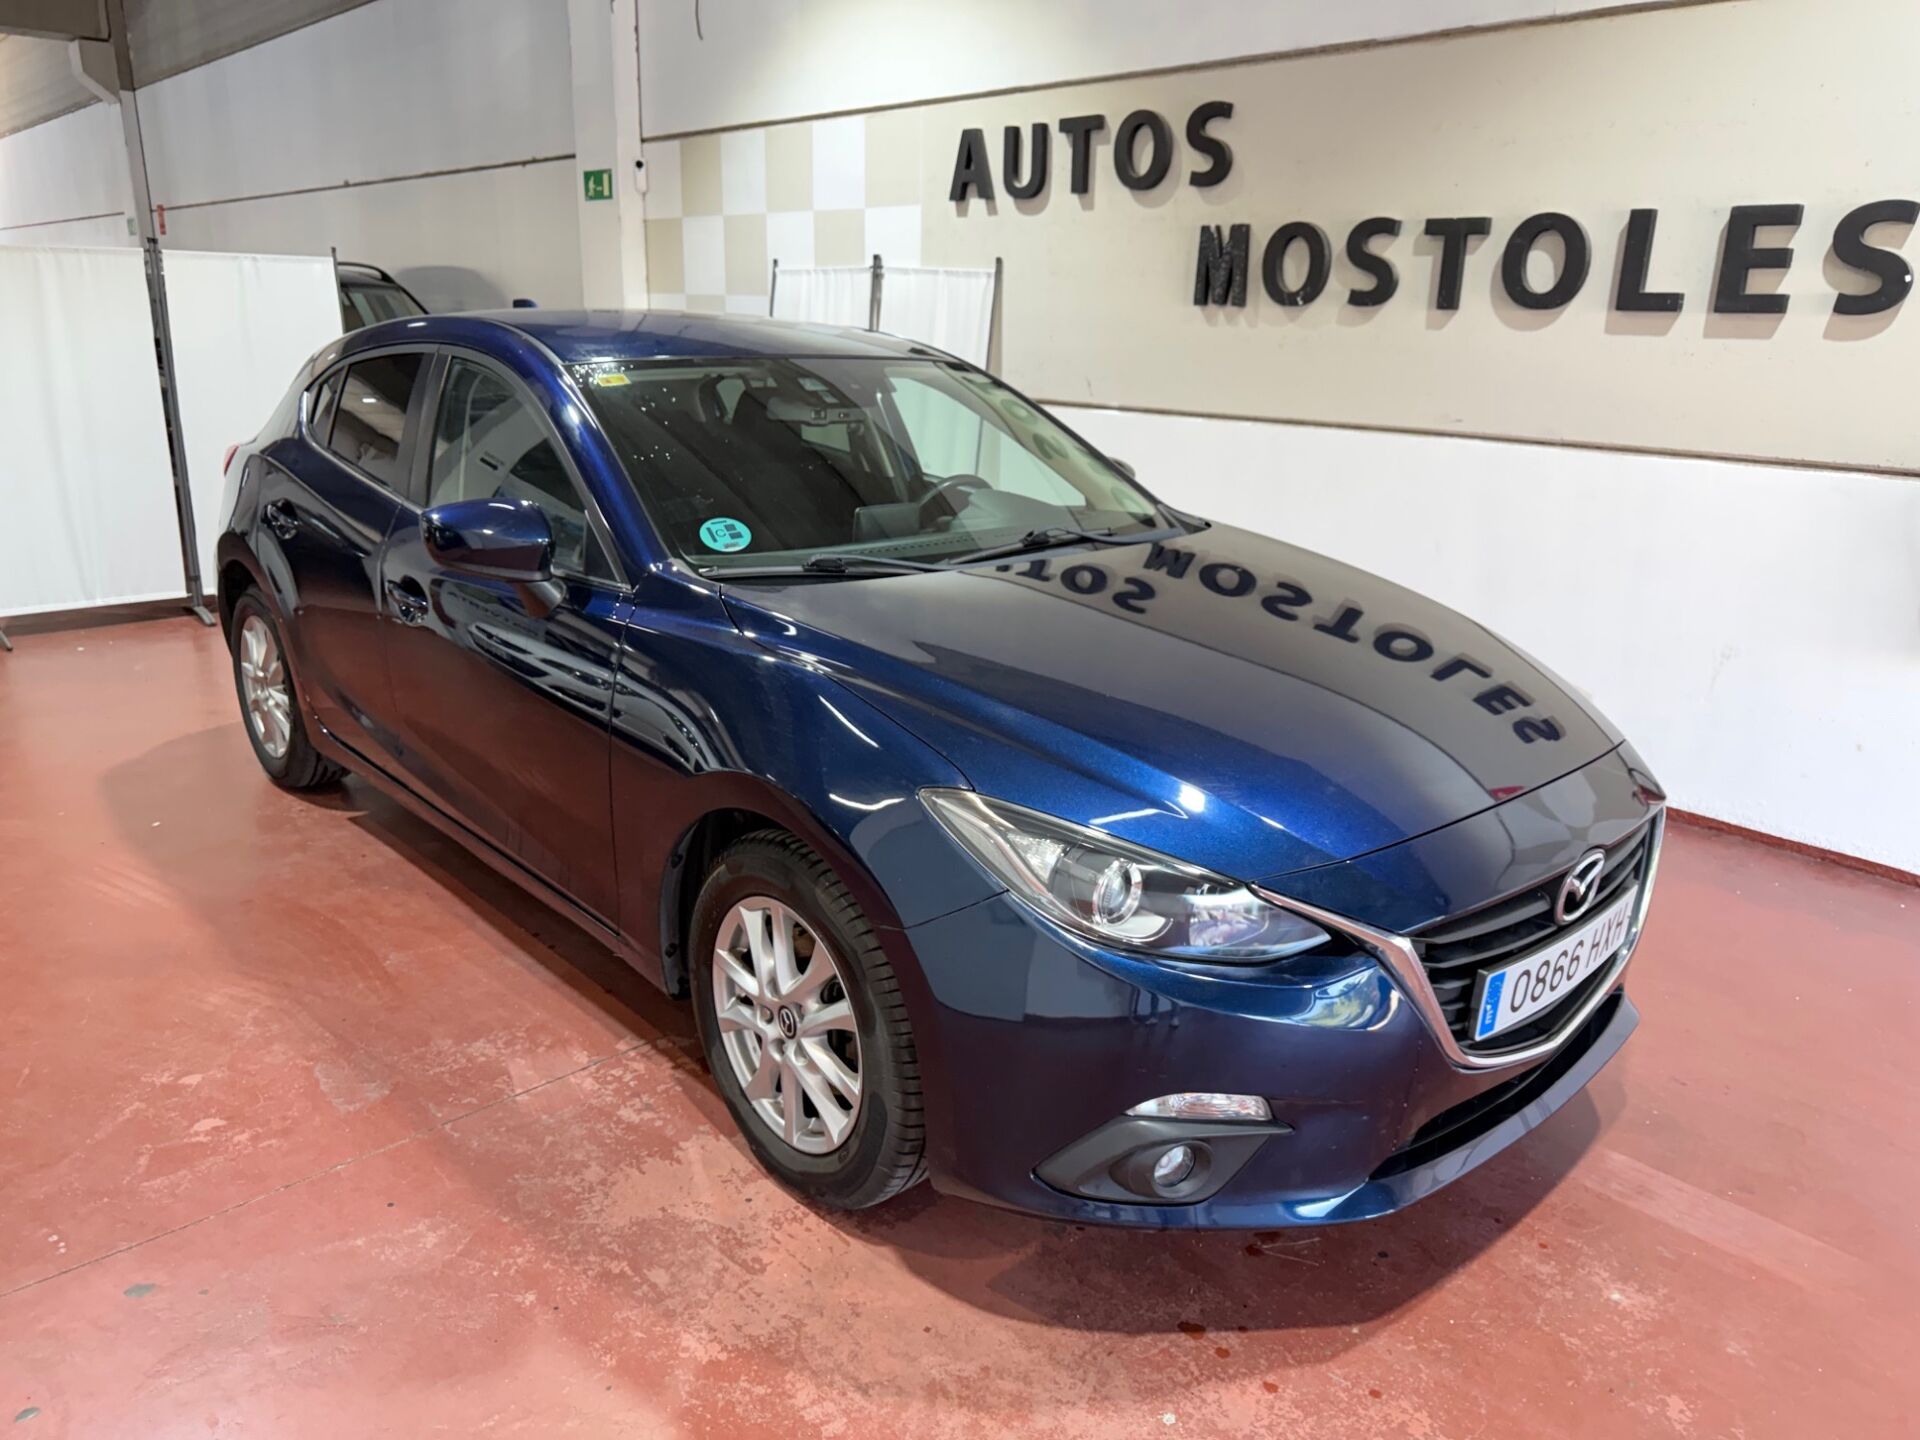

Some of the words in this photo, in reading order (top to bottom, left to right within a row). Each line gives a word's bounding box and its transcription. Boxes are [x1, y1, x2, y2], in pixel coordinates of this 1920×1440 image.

[950, 100, 1233, 200] AUTOS
[1194, 199, 1920, 315] MOSTOLES
[1510, 939, 1584, 1013] 0866
[1585, 901, 1629, 968] HXH
